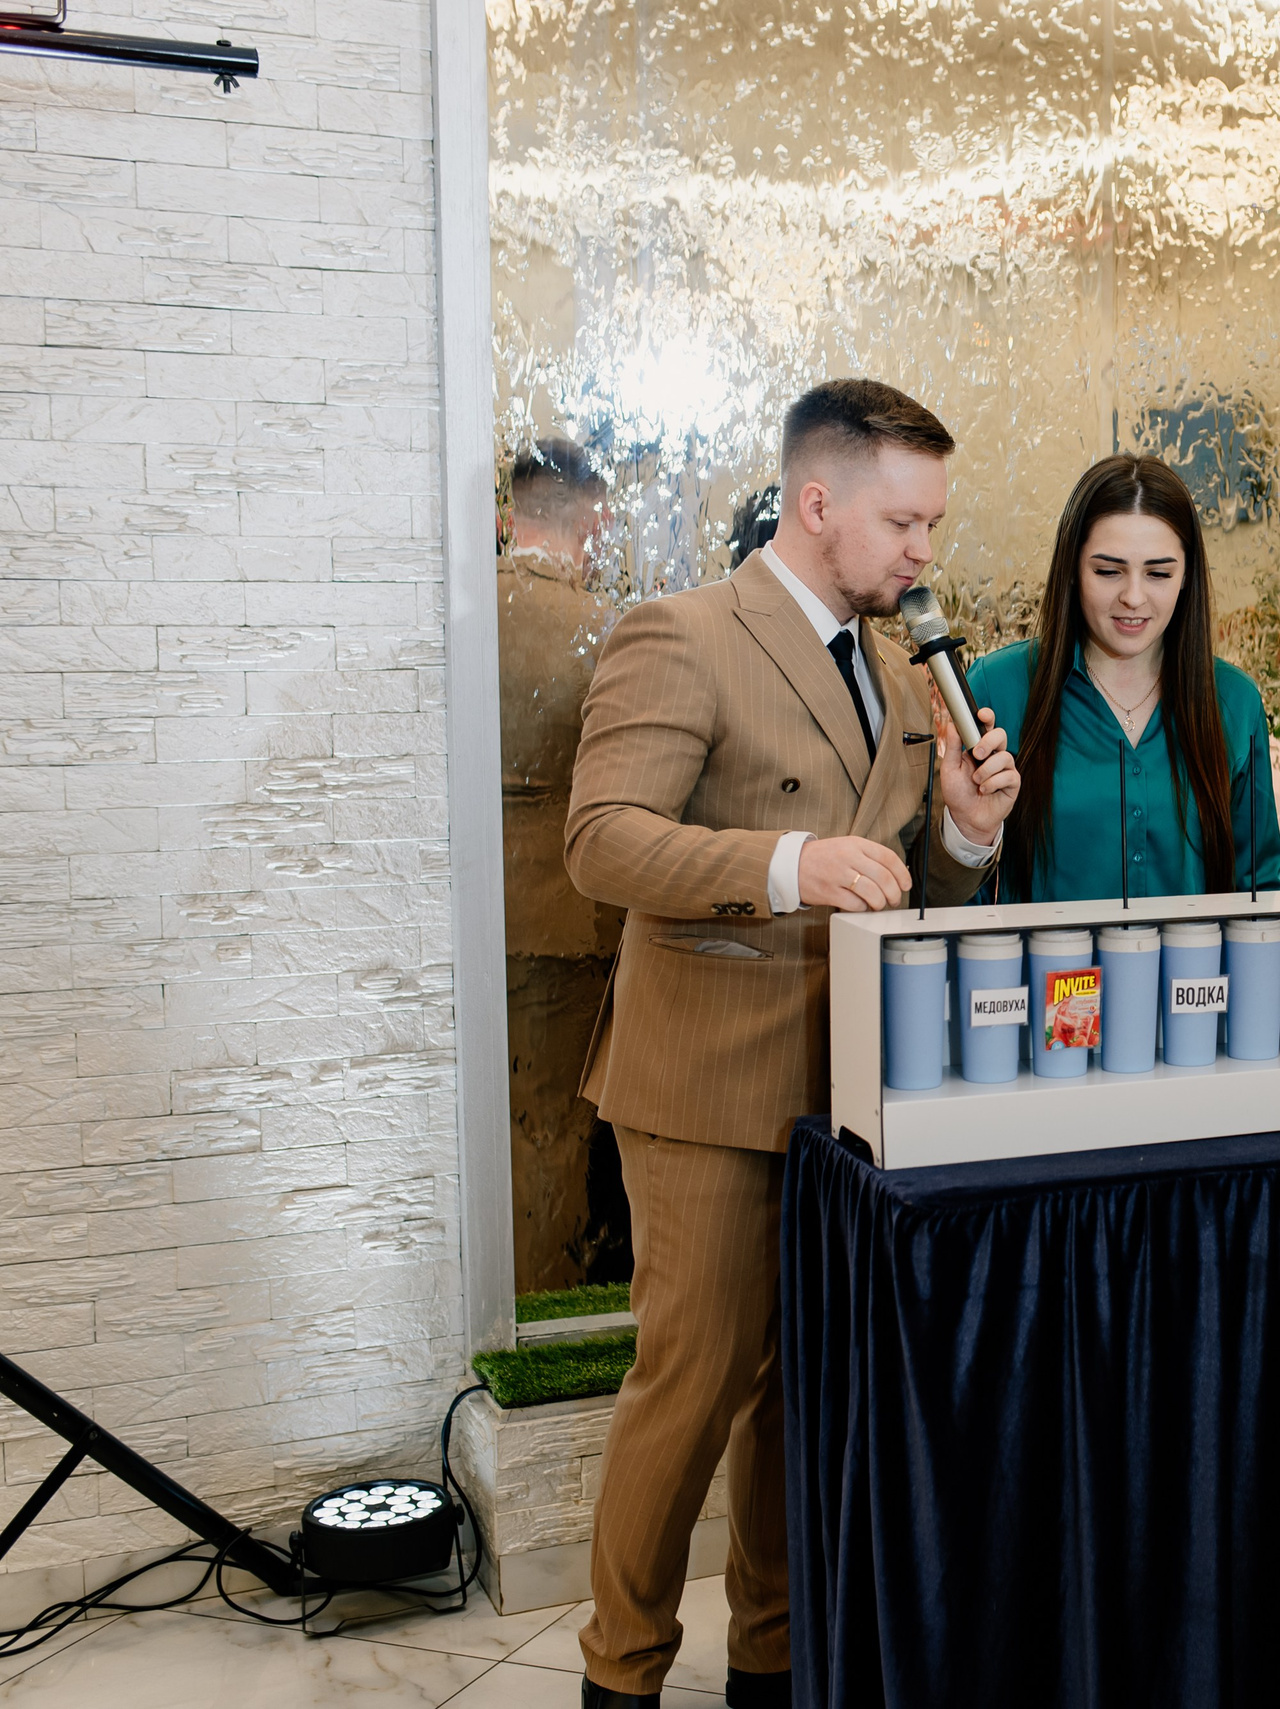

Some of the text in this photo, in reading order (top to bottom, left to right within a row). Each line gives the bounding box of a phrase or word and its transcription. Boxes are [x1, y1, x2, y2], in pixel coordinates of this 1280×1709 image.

[1053, 975, 1096, 1006] INVITE
[1176, 985, 1225, 1007] ВОДКА
[974, 998, 1026, 1014] МЕДОВУХА
